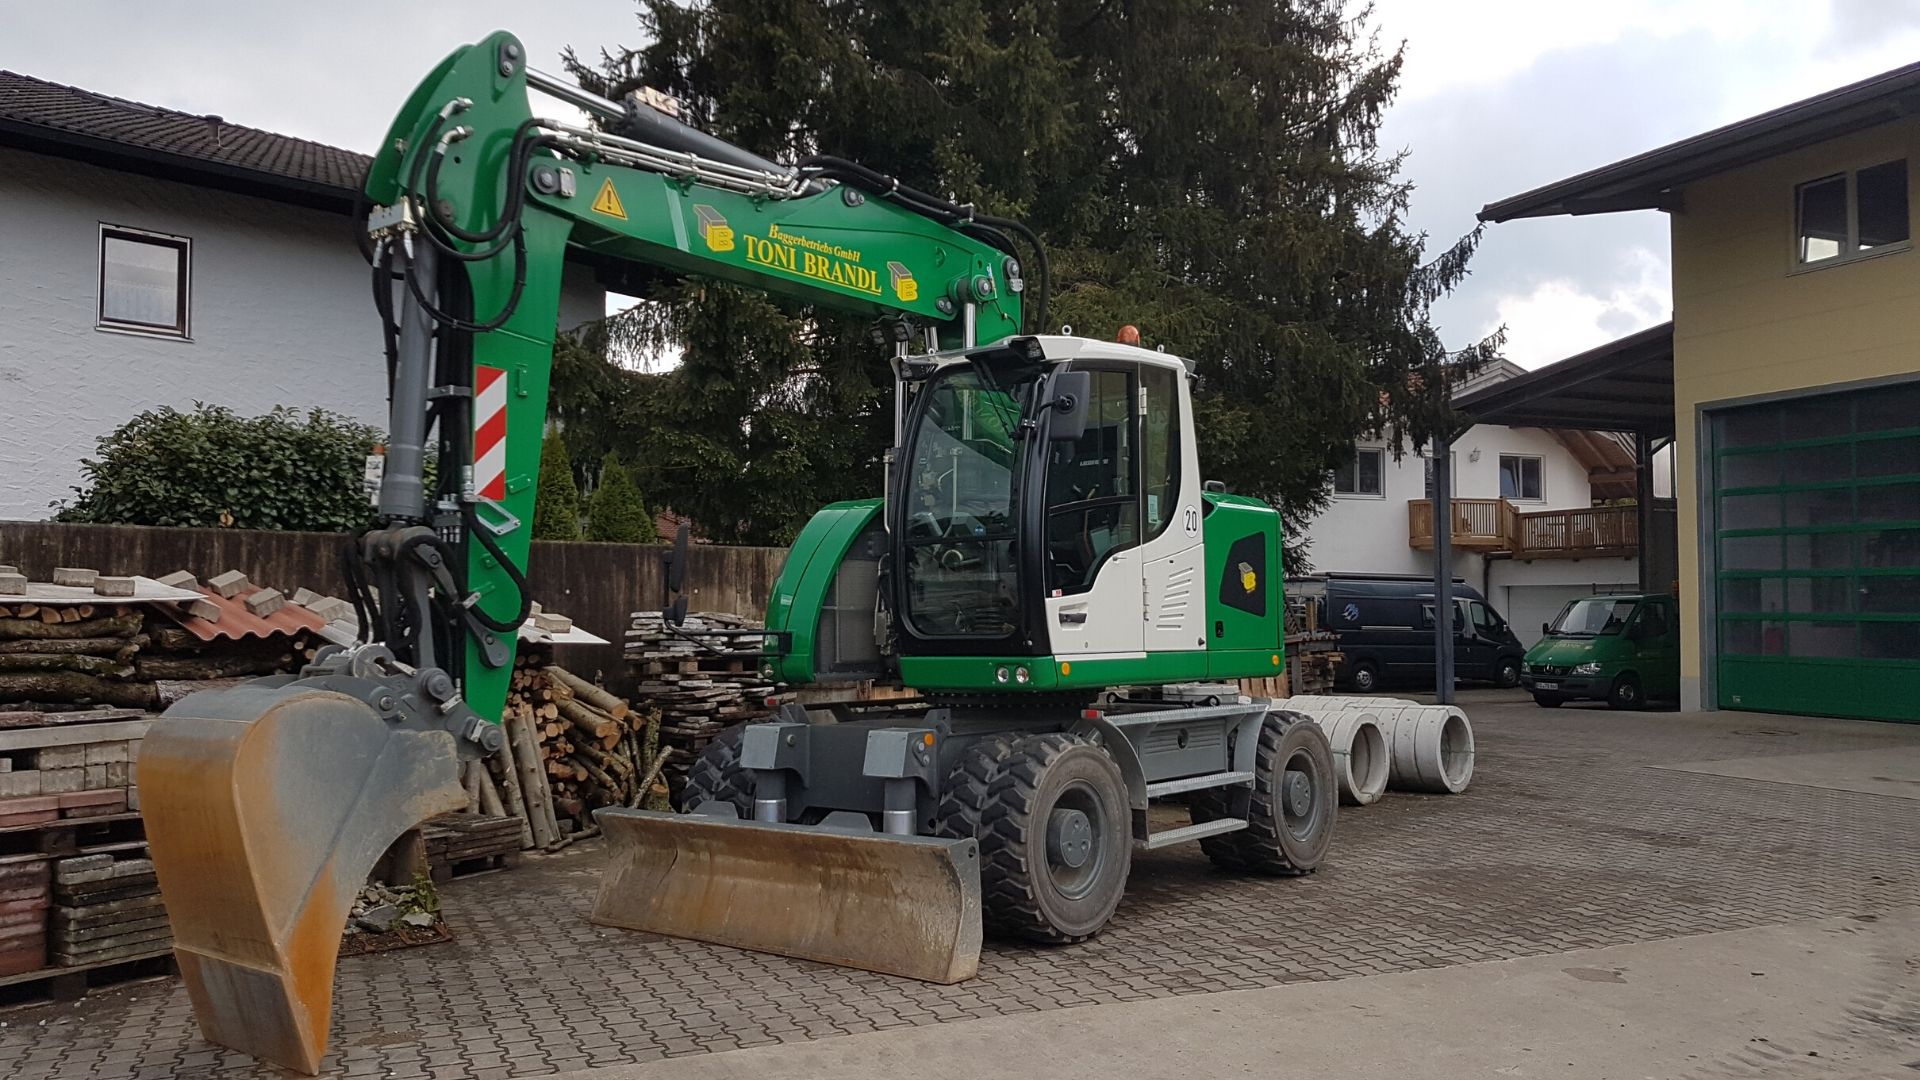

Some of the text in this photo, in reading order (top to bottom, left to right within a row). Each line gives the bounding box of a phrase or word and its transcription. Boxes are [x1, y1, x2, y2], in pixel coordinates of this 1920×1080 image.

[768, 223, 861, 262] Baggerbetriebs GmbH
[744, 234, 882, 293] TONI BRANDL
[1185, 510, 1198, 532] 20
